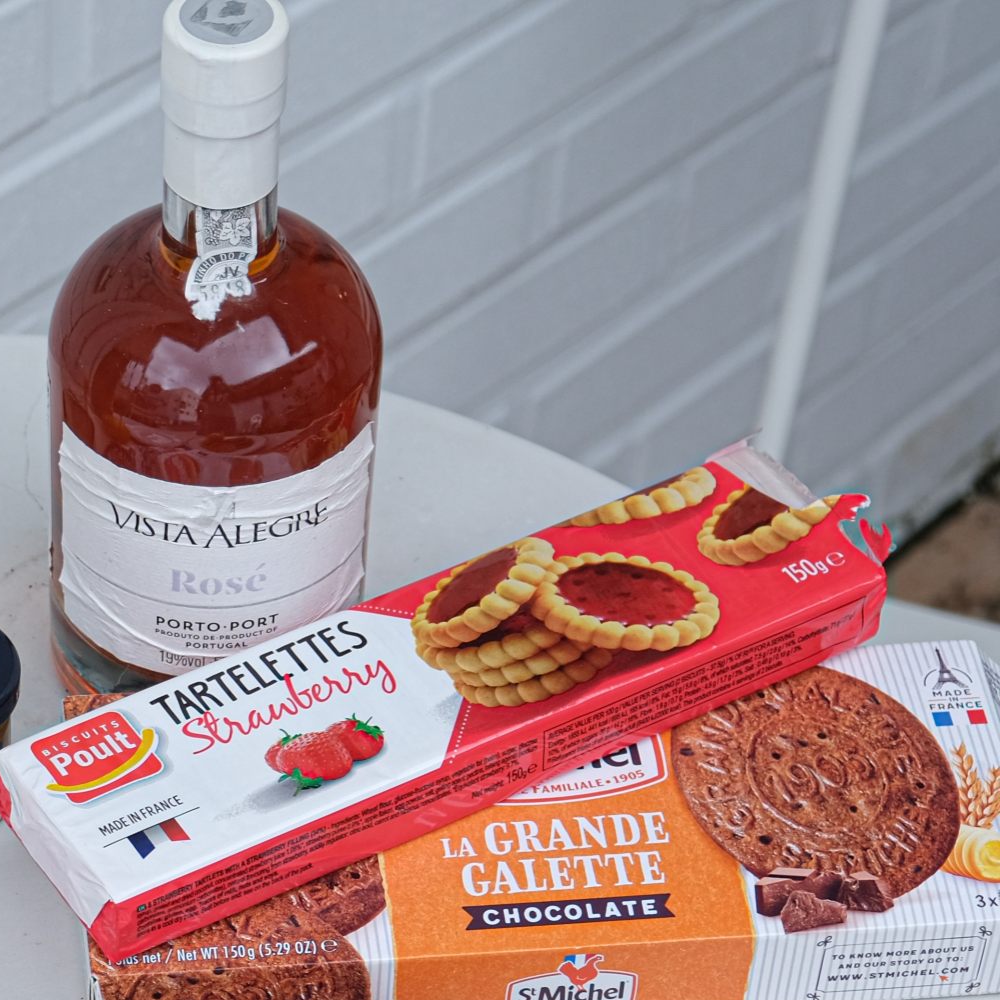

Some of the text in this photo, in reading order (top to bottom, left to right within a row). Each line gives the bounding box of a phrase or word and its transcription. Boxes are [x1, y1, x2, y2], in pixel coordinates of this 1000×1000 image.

[194, 257, 217, 283] VINHO
[220, 252, 235, 261] DO
[107, 496, 330, 549] VISTA ALEGRE
[170, 562, 268, 596] Rosé
[780, 557, 830, 585] 150g
[154, 628, 201, 641] PRODUTO
[266, 626, 278, 635] OF
[185, 641, 248, 650] PORTUGAL
[149, 620, 368, 725] TARTELETTES
[181, 659, 397, 755] Strawberry
[929, 701, 983, 710] FRANCE
[932, 688, 972, 698] MADE
[42, 720, 120, 757] BISCUITS
[49, 732, 137, 777] Poult
[532, 778, 604, 794] FAMILIALE
[612, 769, 645, 784] 1905
[98, 795, 185, 837] MADE IN FRANCE
[440, 811, 670, 859] LA GRANDE
[151, 883, 193, 905] STRAWBERRY
[193, 869, 224, 887] TARTLETS
[461, 850, 666, 897] GALETTE
[482, 898, 658, 926] CHOCOLATE
[142, 952, 161, 964] net
[177, 949, 197, 962] Net
[200, 946, 219, 960] WT
[258, 941, 291, 957] (5.29
[295, 940, 317, 955] OZ)
[832, 945, 975, 961] TO KNOW MORE ABOUT US
[838, 955, 964, 970] AND OUR STORY GO TO:
[827, 966, 970, 982] WWW.STMICHEL.COM
